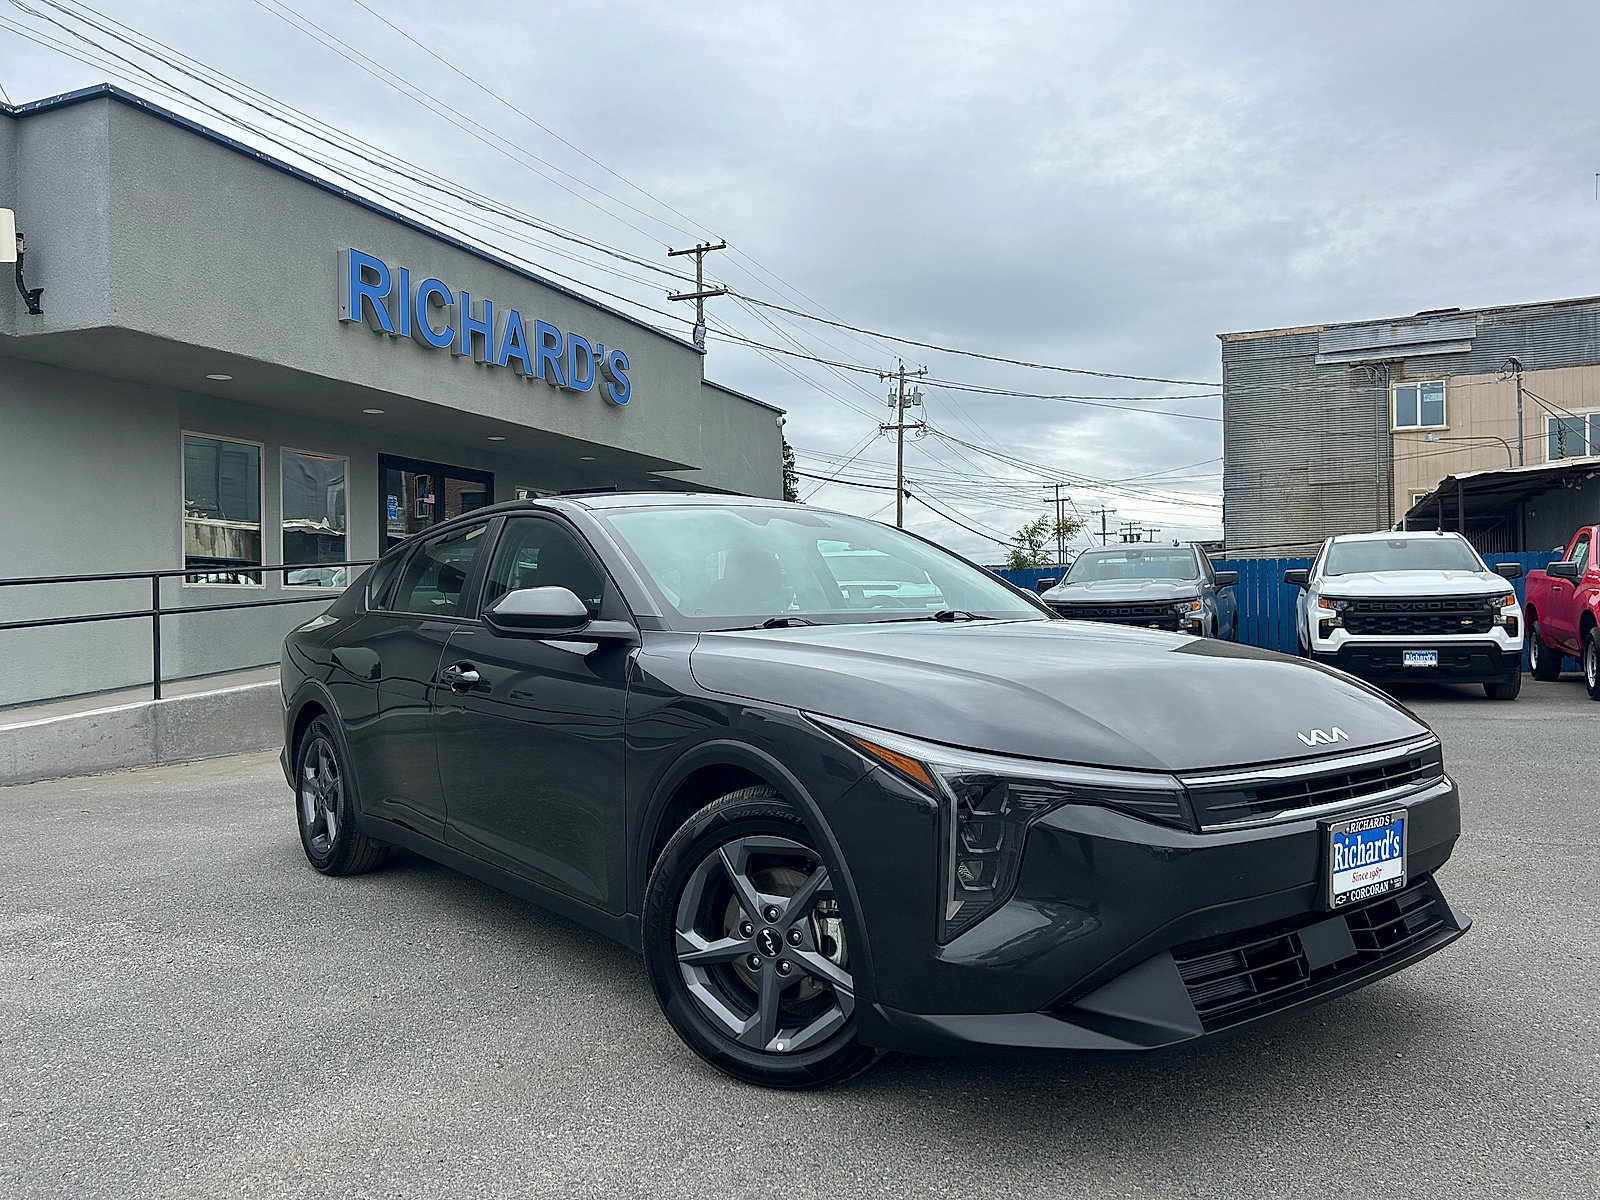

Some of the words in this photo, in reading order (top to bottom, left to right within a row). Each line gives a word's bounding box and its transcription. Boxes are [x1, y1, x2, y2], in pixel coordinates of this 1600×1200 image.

[348, 247, 632, 406] RICHARD'S
[1357, 601, 1484, 611] CHEVROLET
[1297, 726, 1349, 746] KIA
[733, 810, 803, 823] 205/55R1
[1333, 829, 1400, 871] Richard's
[1352, 871, 1368, 883] Since
[1369, 867, 1382, 880] 1987
[1350, 881, 1389, 901] CORCORAN
